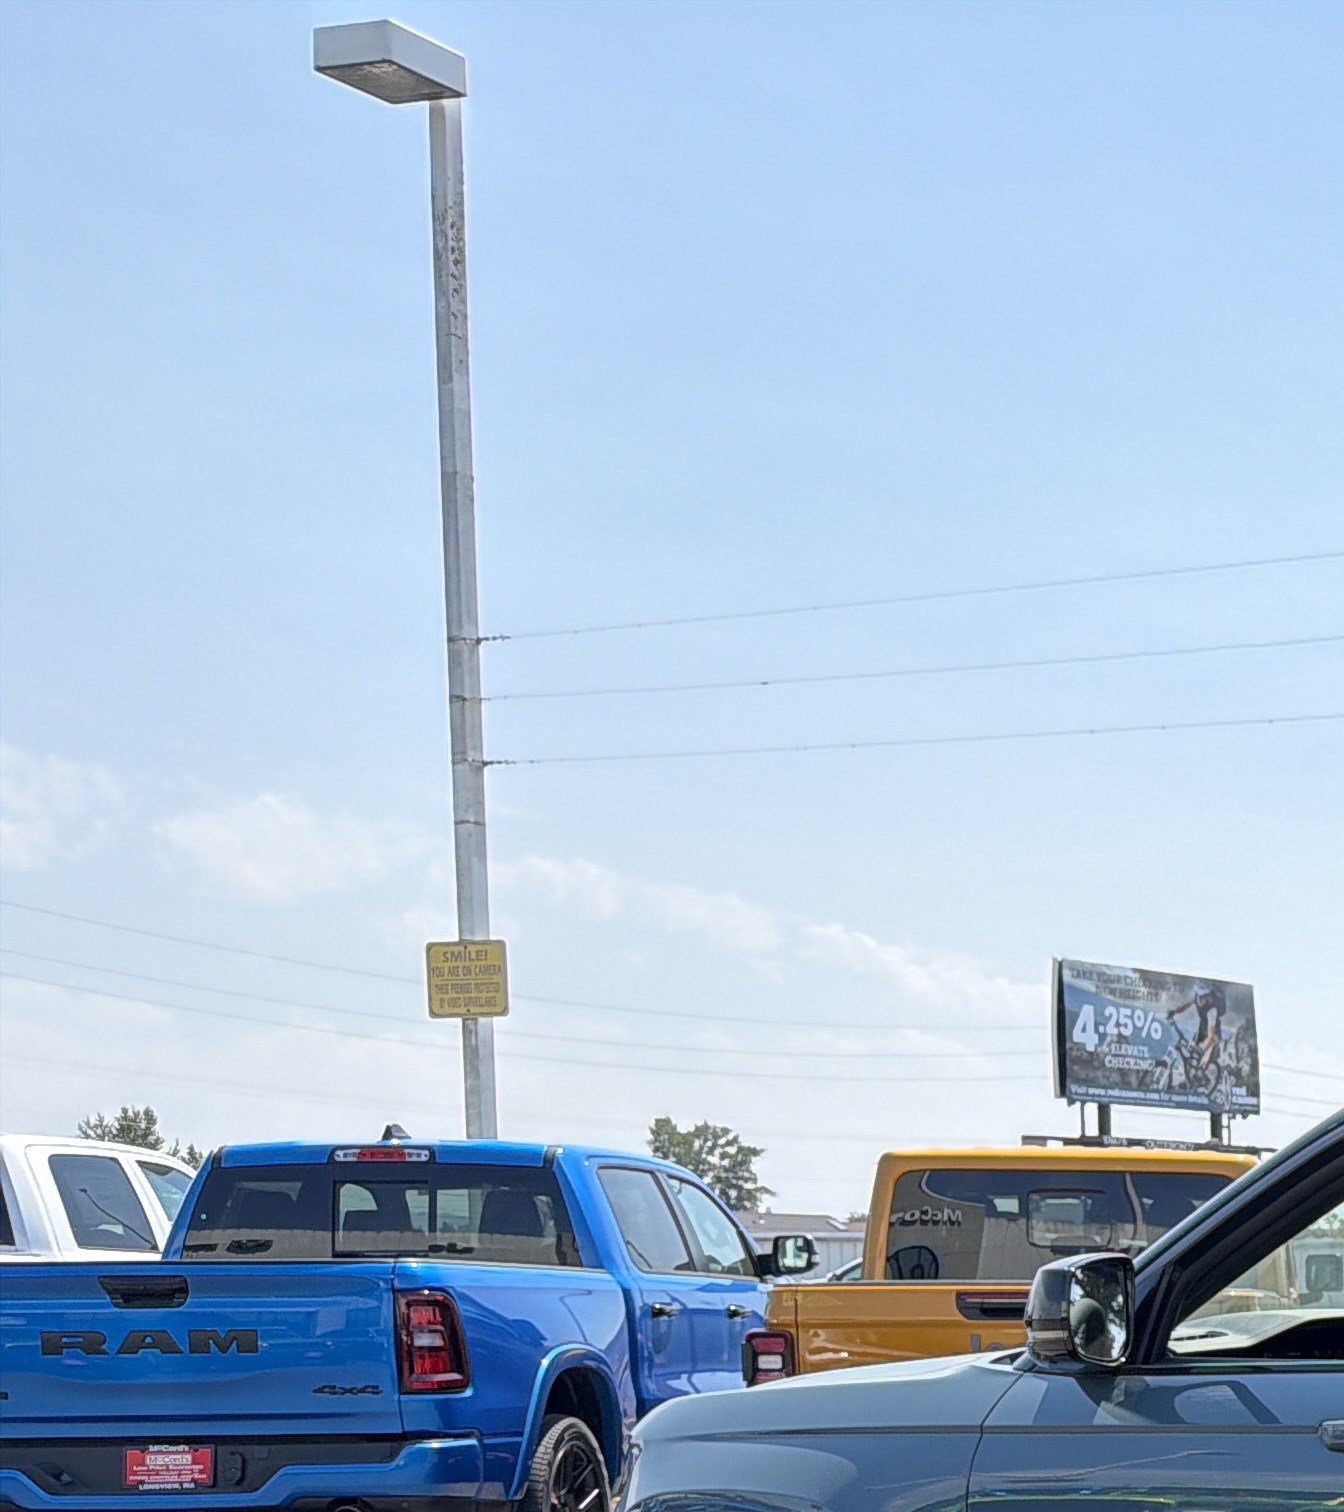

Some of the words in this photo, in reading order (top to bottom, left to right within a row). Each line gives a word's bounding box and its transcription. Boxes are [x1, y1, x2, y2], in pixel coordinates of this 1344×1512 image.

[442, 949, 488, 963] SMILE!
[431, 966, 445, 978] YOU
[447, 965, 460, 977] ARE
[462, 965, 472, 977] ON
[474, 964, 502, 976] CAMERA
[1072, 1004, 1163, 1053] 4.25%
[40, 1329, 260, 1356] RAM
[311, 1384, 384, 1396] 4x4
[148, 1455, 191, 1464] McCord's
